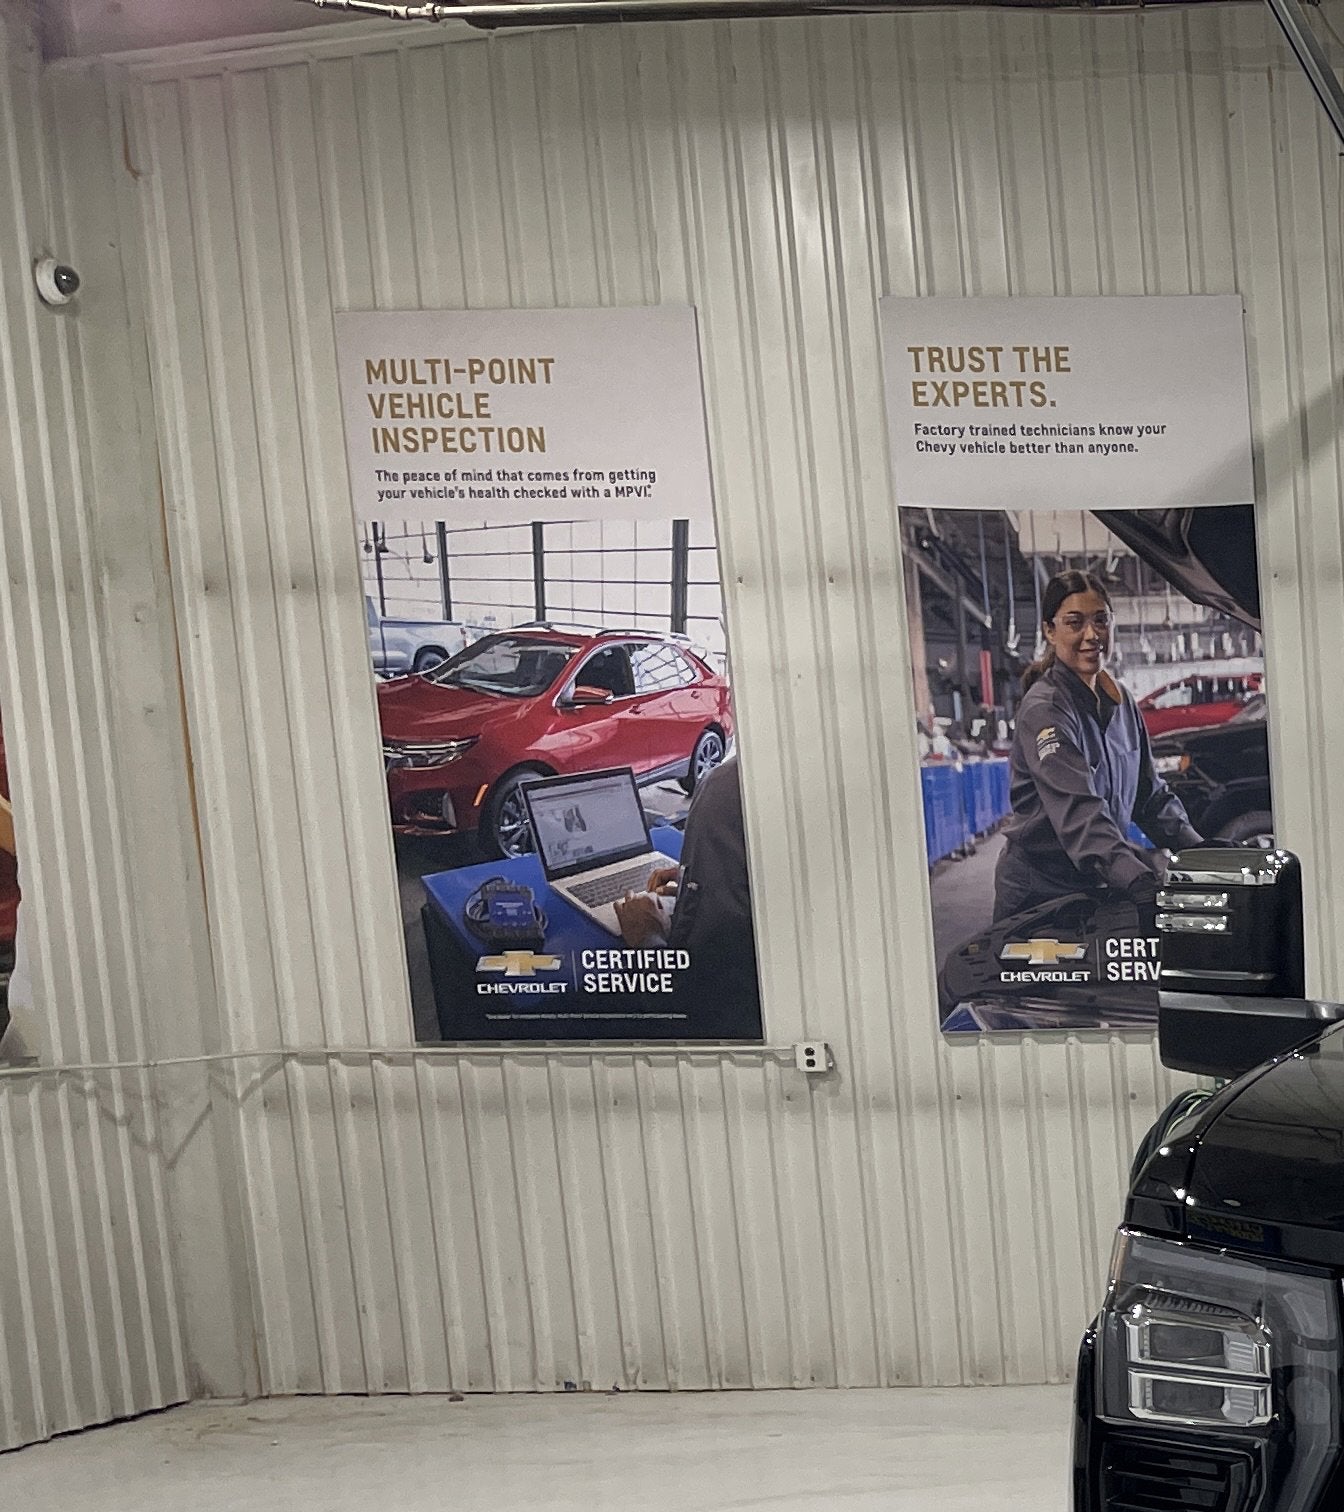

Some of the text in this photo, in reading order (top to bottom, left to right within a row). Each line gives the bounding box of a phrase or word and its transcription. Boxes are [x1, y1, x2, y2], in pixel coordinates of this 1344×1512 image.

[907, 346, 1071, 373] TRUST THE
[365, 358, 555, 385] MULTI-POINT
[367, 392, 492, 419] VEHICLE
[912, 381, 1057, 408] EXPERTS.
[372, 427, 547, 453] INSPECTION
[914, 422, 1167, 438] Factory trained technicians know your
[916, 440, 1139, 456] Chevy vehicle better than anyone.
[375, 467, 656, 485] The peace of mind that comes from getting
[377, 488, 406, 501] your
[410, 486, 465, 499] vehicle's
[469, 486, 510, 499] health
[513, 486, 567, 499] checked
[571, 485, 600, 498] with
[604, 488, 611, 498] a
[582, 948, 690, 970] CERTIFIED
[1105, 937, 1160, 959] CERT
[1000, 970, 1091, 983] CHEVROLET
[1106, 960, 1162, 982] SERV
[477, 982, 569, 994] CHEVROLET
[584, 972, 674, 993] SERVICE
